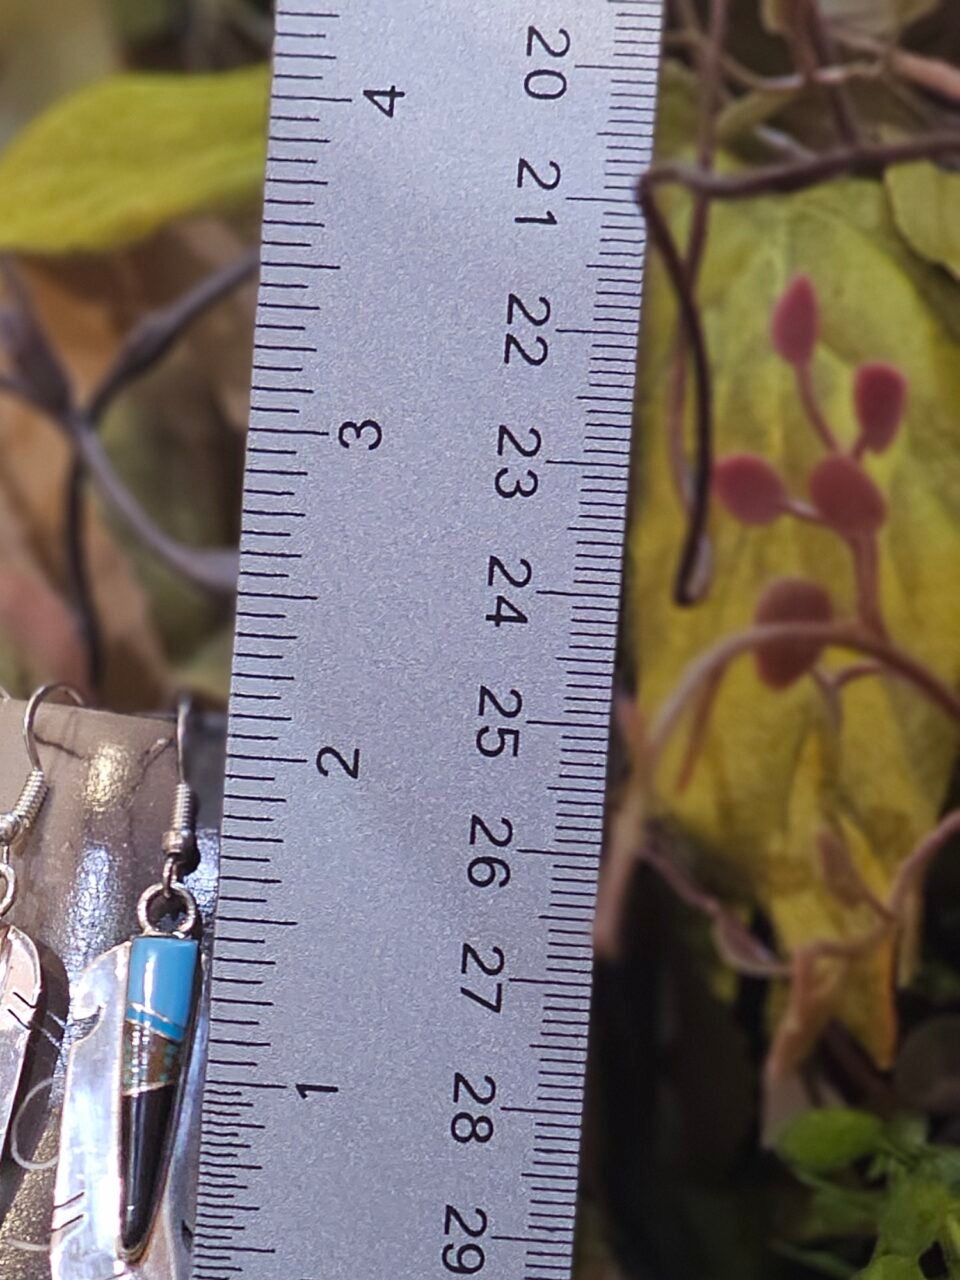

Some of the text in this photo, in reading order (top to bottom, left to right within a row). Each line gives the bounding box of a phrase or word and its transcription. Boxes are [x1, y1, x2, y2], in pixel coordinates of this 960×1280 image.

[523, 25, 571, 101] 20
[362, 84, 406, 119] 4
[514, 157, 562, 226] 21
[503, 292, 551, 367] 22
[337, 418, 383, 451] 3
[494, 424, 542, 499] 23
[485, 555, 533, 628] 24
[475, 684, 523, 758] 25
[315, 745, 360, 780] 2
[466, 814, 514, 888] 26
[459, 942, 505, 1014] 27
[295, 1083, 340, 1100] 1
[450, 1071, 497, 1144] 28
[441, 1204, 488, 1275] 29
